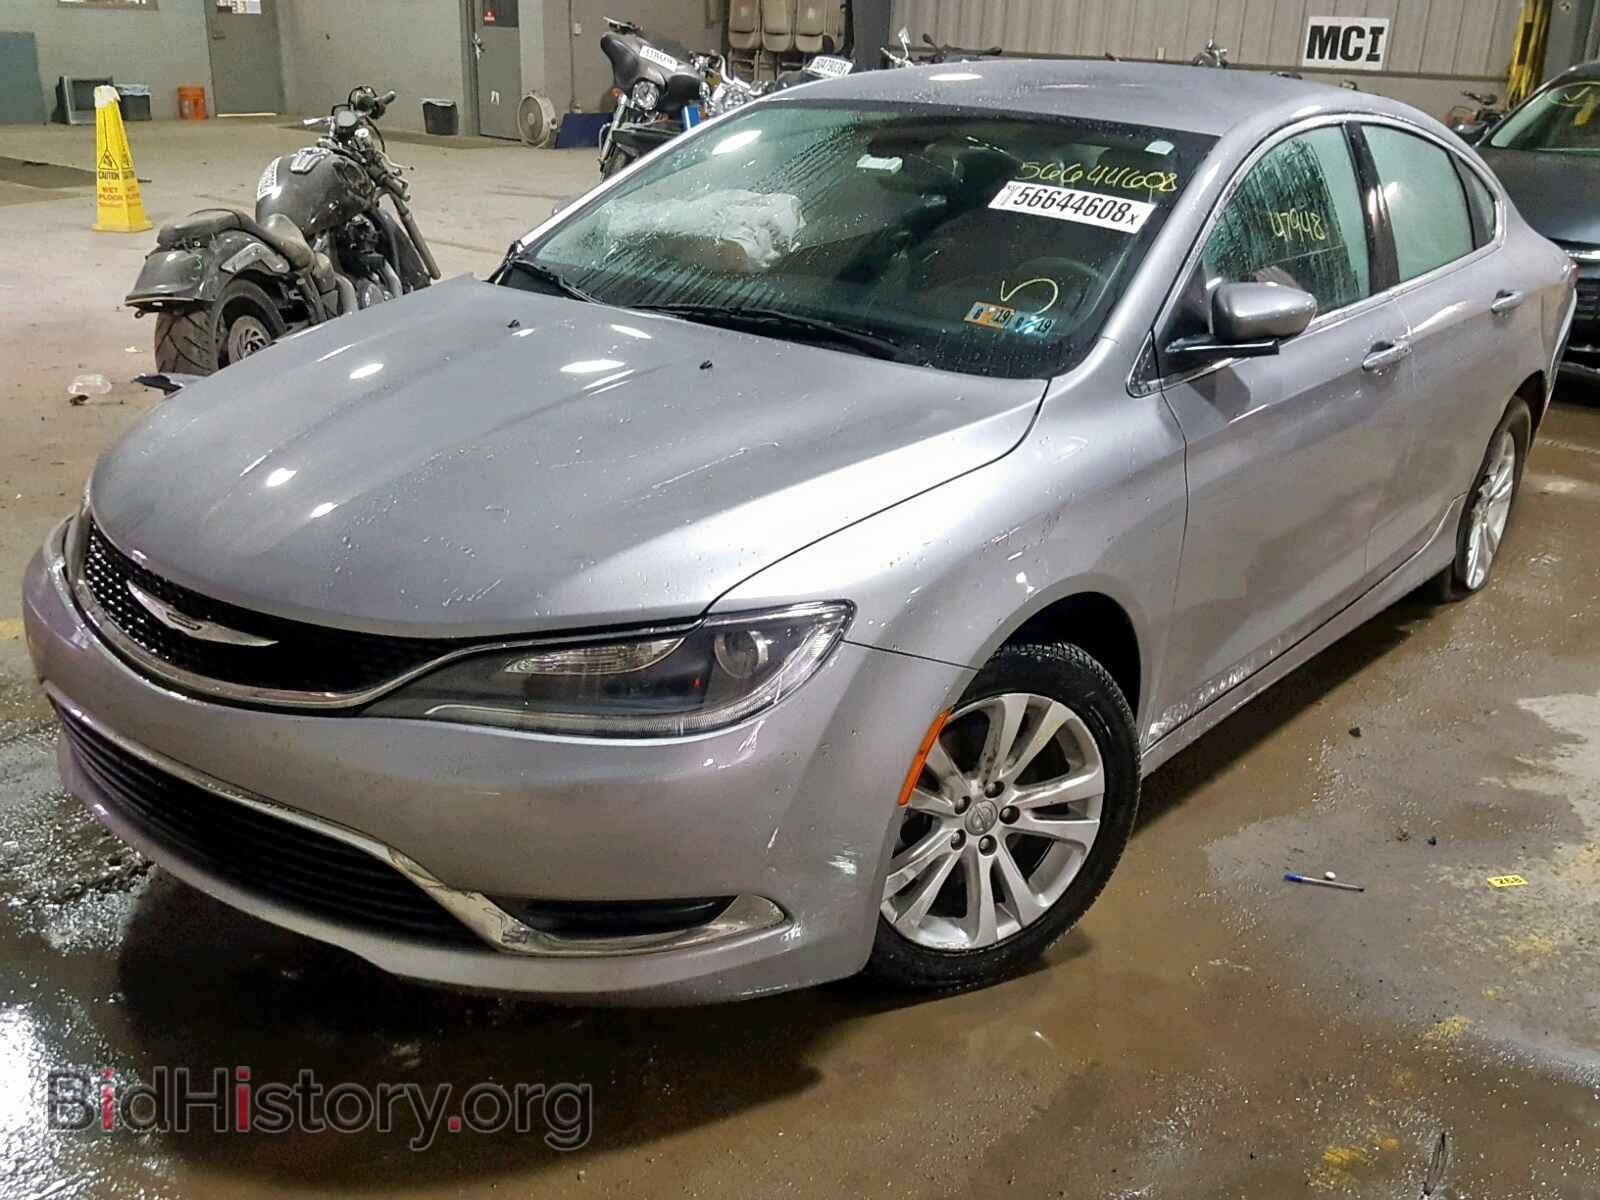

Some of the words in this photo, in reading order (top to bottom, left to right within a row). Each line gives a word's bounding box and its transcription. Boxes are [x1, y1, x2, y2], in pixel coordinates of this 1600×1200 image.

[1306, 25, 1385, 62] MCI
[1014, 160, 1178, 192] 56644608
[1270, 207, 1326, 242] 47948
